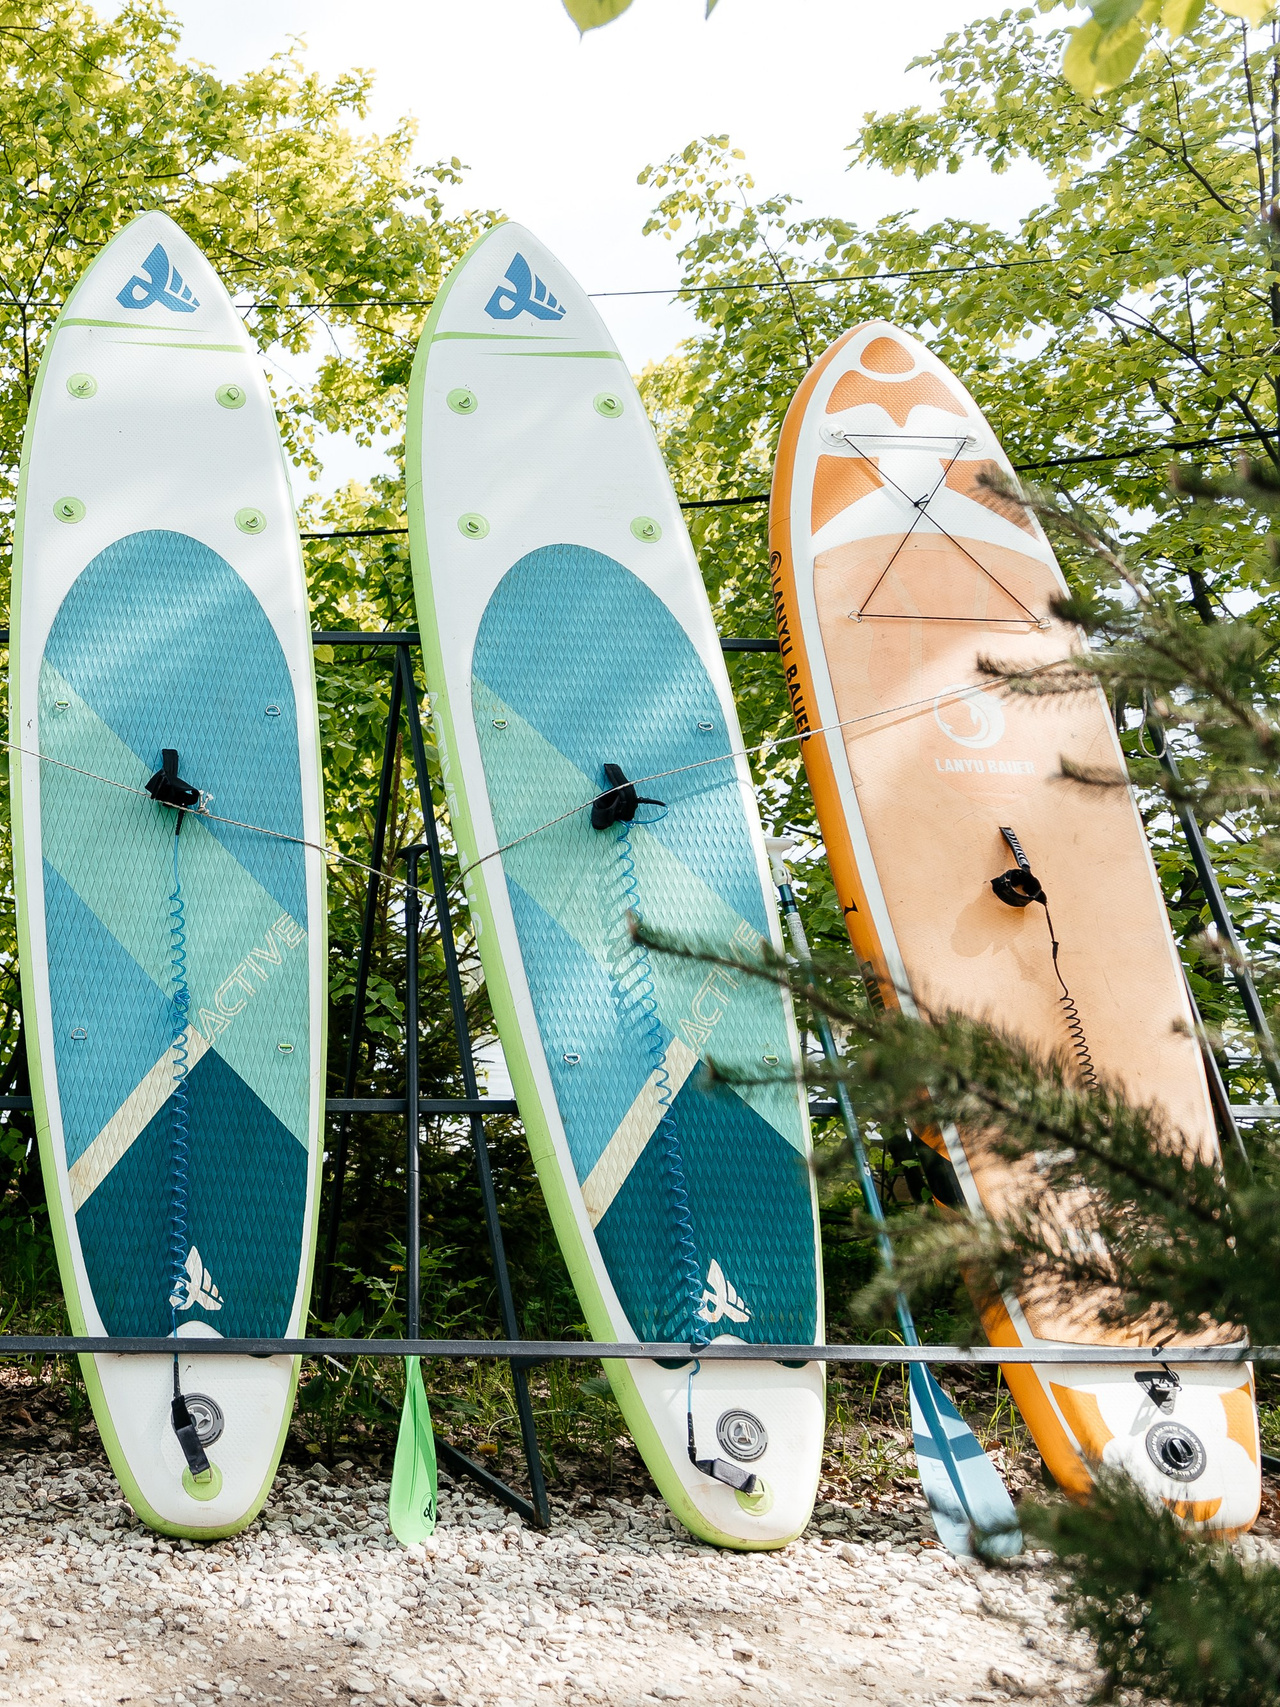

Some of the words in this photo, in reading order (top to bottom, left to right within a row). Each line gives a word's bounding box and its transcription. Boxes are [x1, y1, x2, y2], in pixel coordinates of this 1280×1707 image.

[772, 576, 793, 657] LANYU
[786, 663, 812, 747] BAUER
[934, 758, 985, 773] LANYU
[987, 760, 1035, 774] BAUER
[198, 912, 308, 1046] ACTIVE
